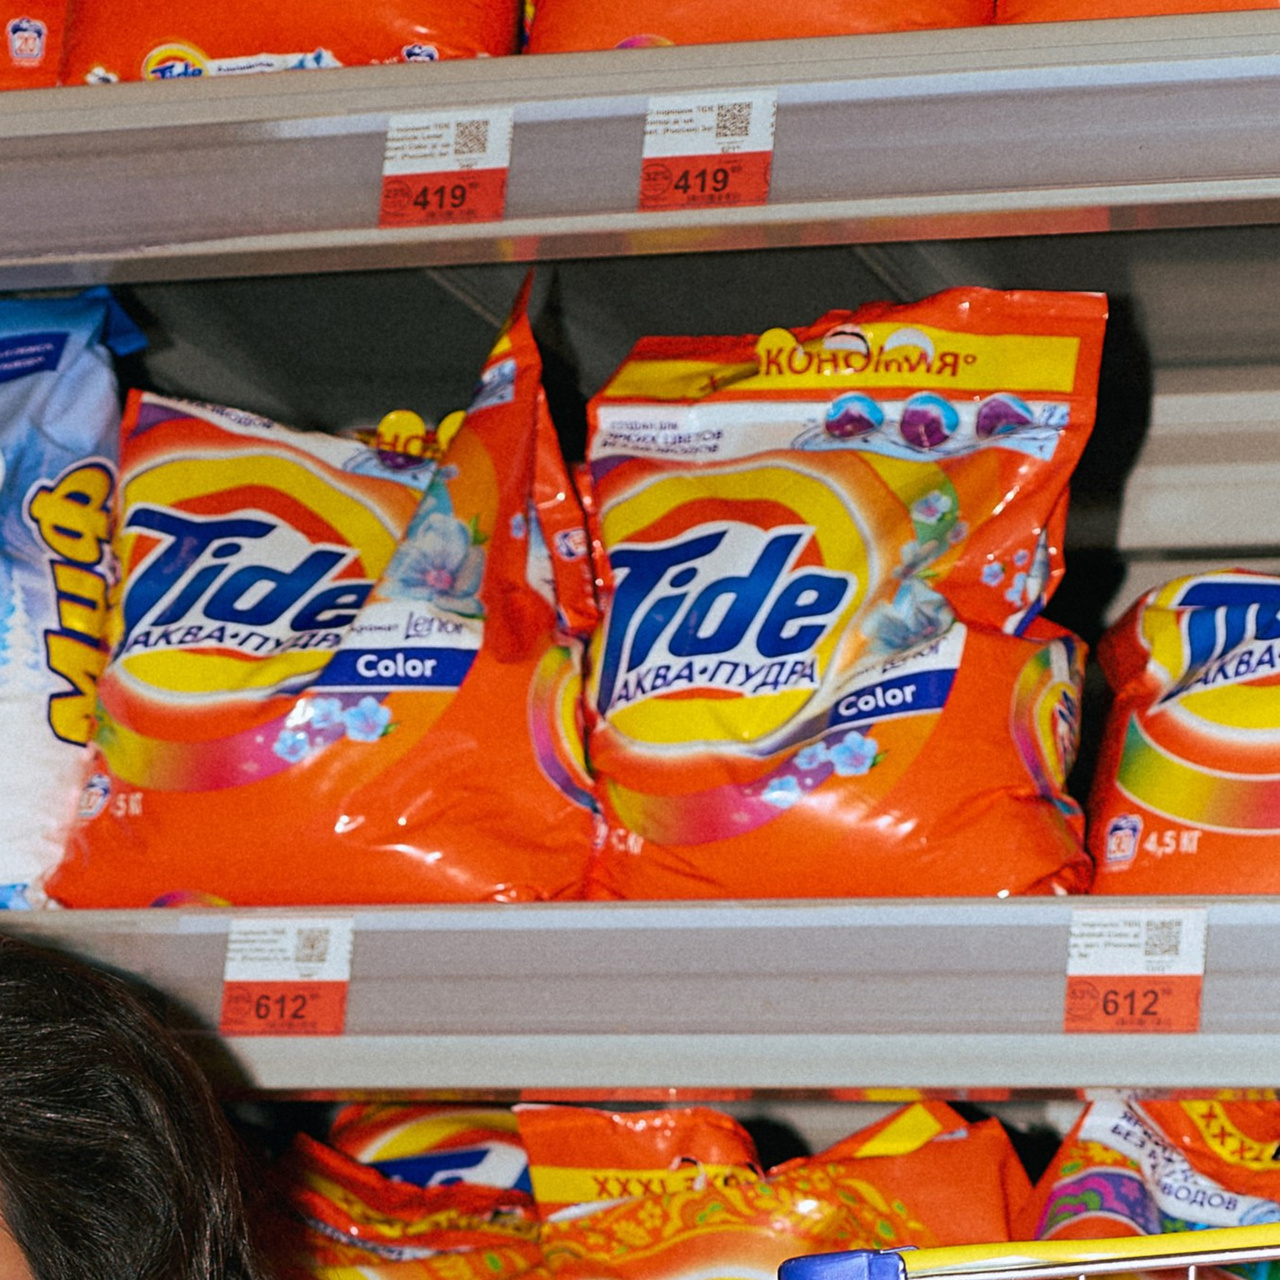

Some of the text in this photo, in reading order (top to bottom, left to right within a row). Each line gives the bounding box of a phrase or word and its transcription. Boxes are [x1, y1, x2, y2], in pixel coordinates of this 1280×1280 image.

[674, 168, 730, 195] 419
[413, 184, 467, 210] 419
[117, 506, 377, 655] Tide
[600, 528, 850, 713] Tide
[356, 652, 438, 678] Color
[838, 684, 917, 717] Color
[255, 994, 307, 1019] 612
[1102, 989, 1159, 1016] 612
